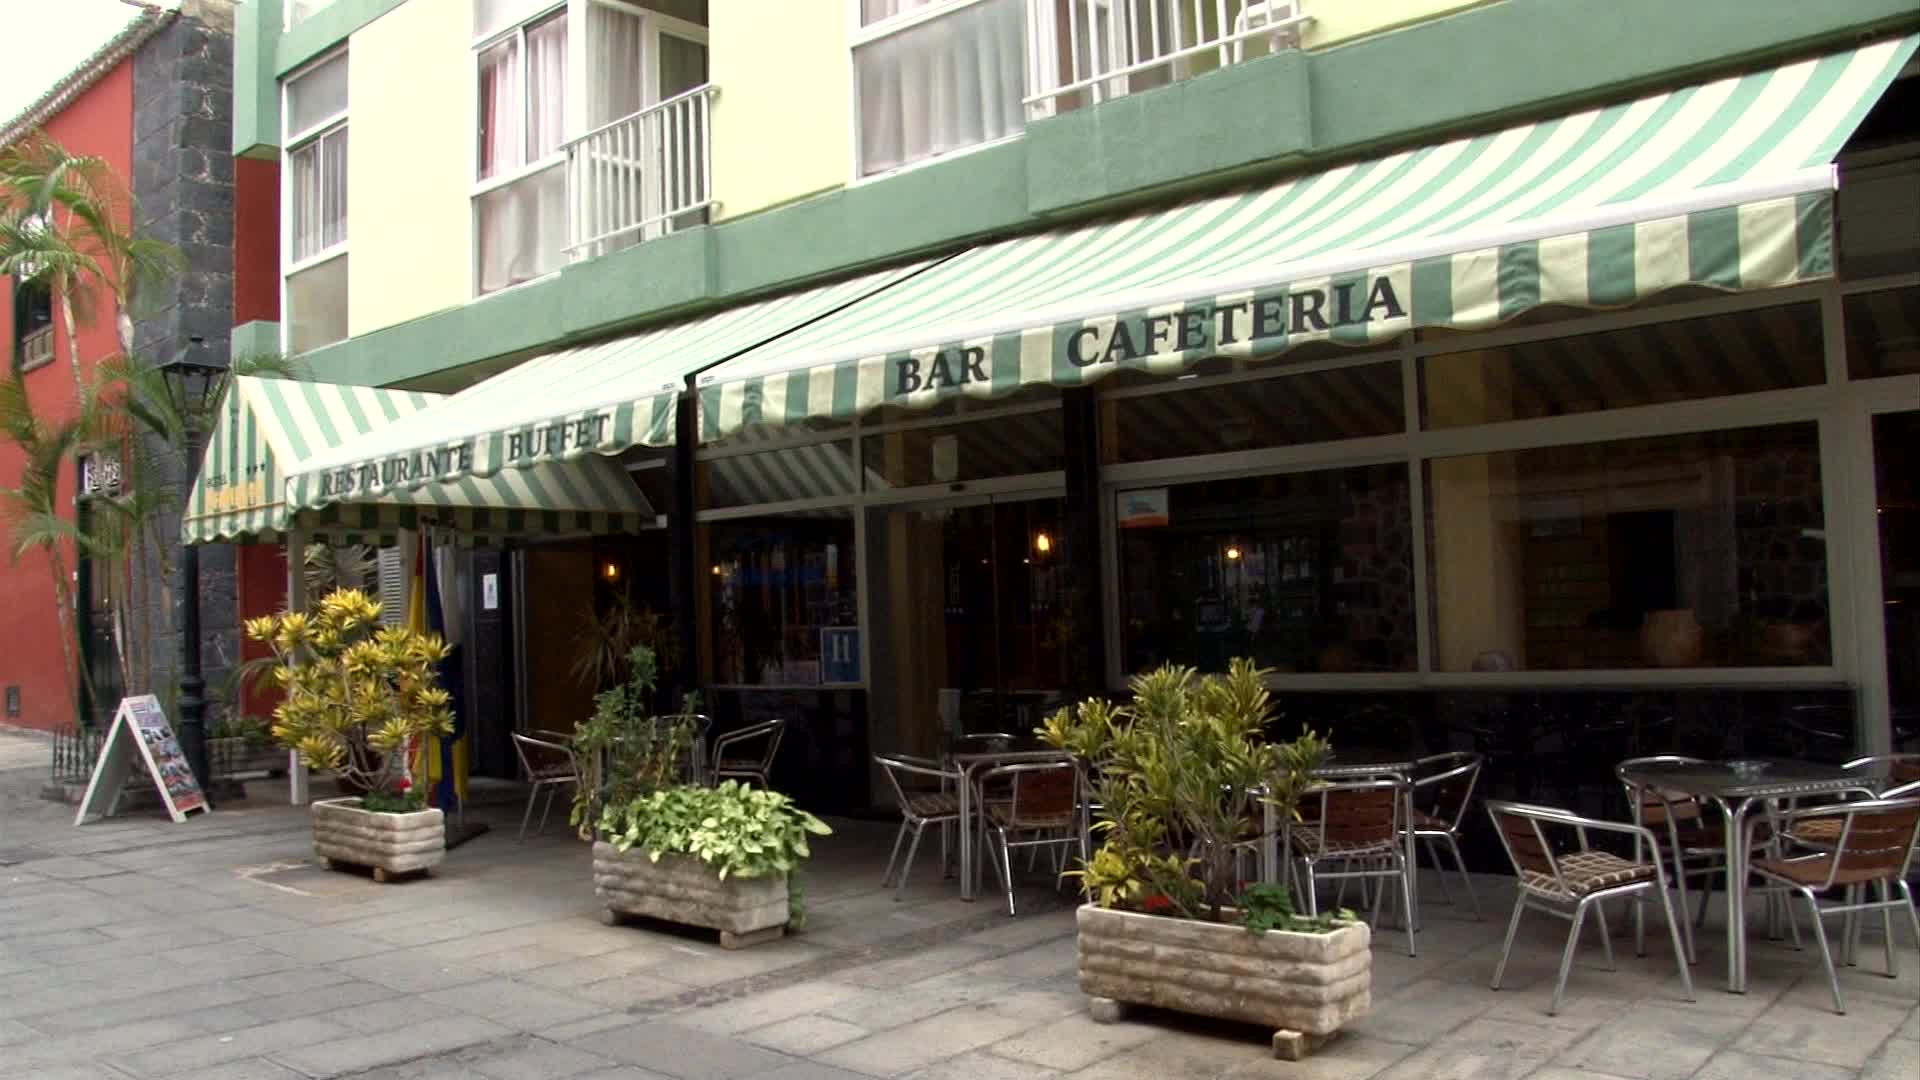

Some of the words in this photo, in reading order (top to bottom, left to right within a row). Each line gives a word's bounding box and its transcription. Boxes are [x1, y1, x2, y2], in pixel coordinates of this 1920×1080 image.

[896, 345, 990, 396] BAR
[1067, 276, 1408, 367] CAFETERIA
[321, 443, 473, 497] RESTAURANTE
[508, 415, 611, 462] BUFFET
